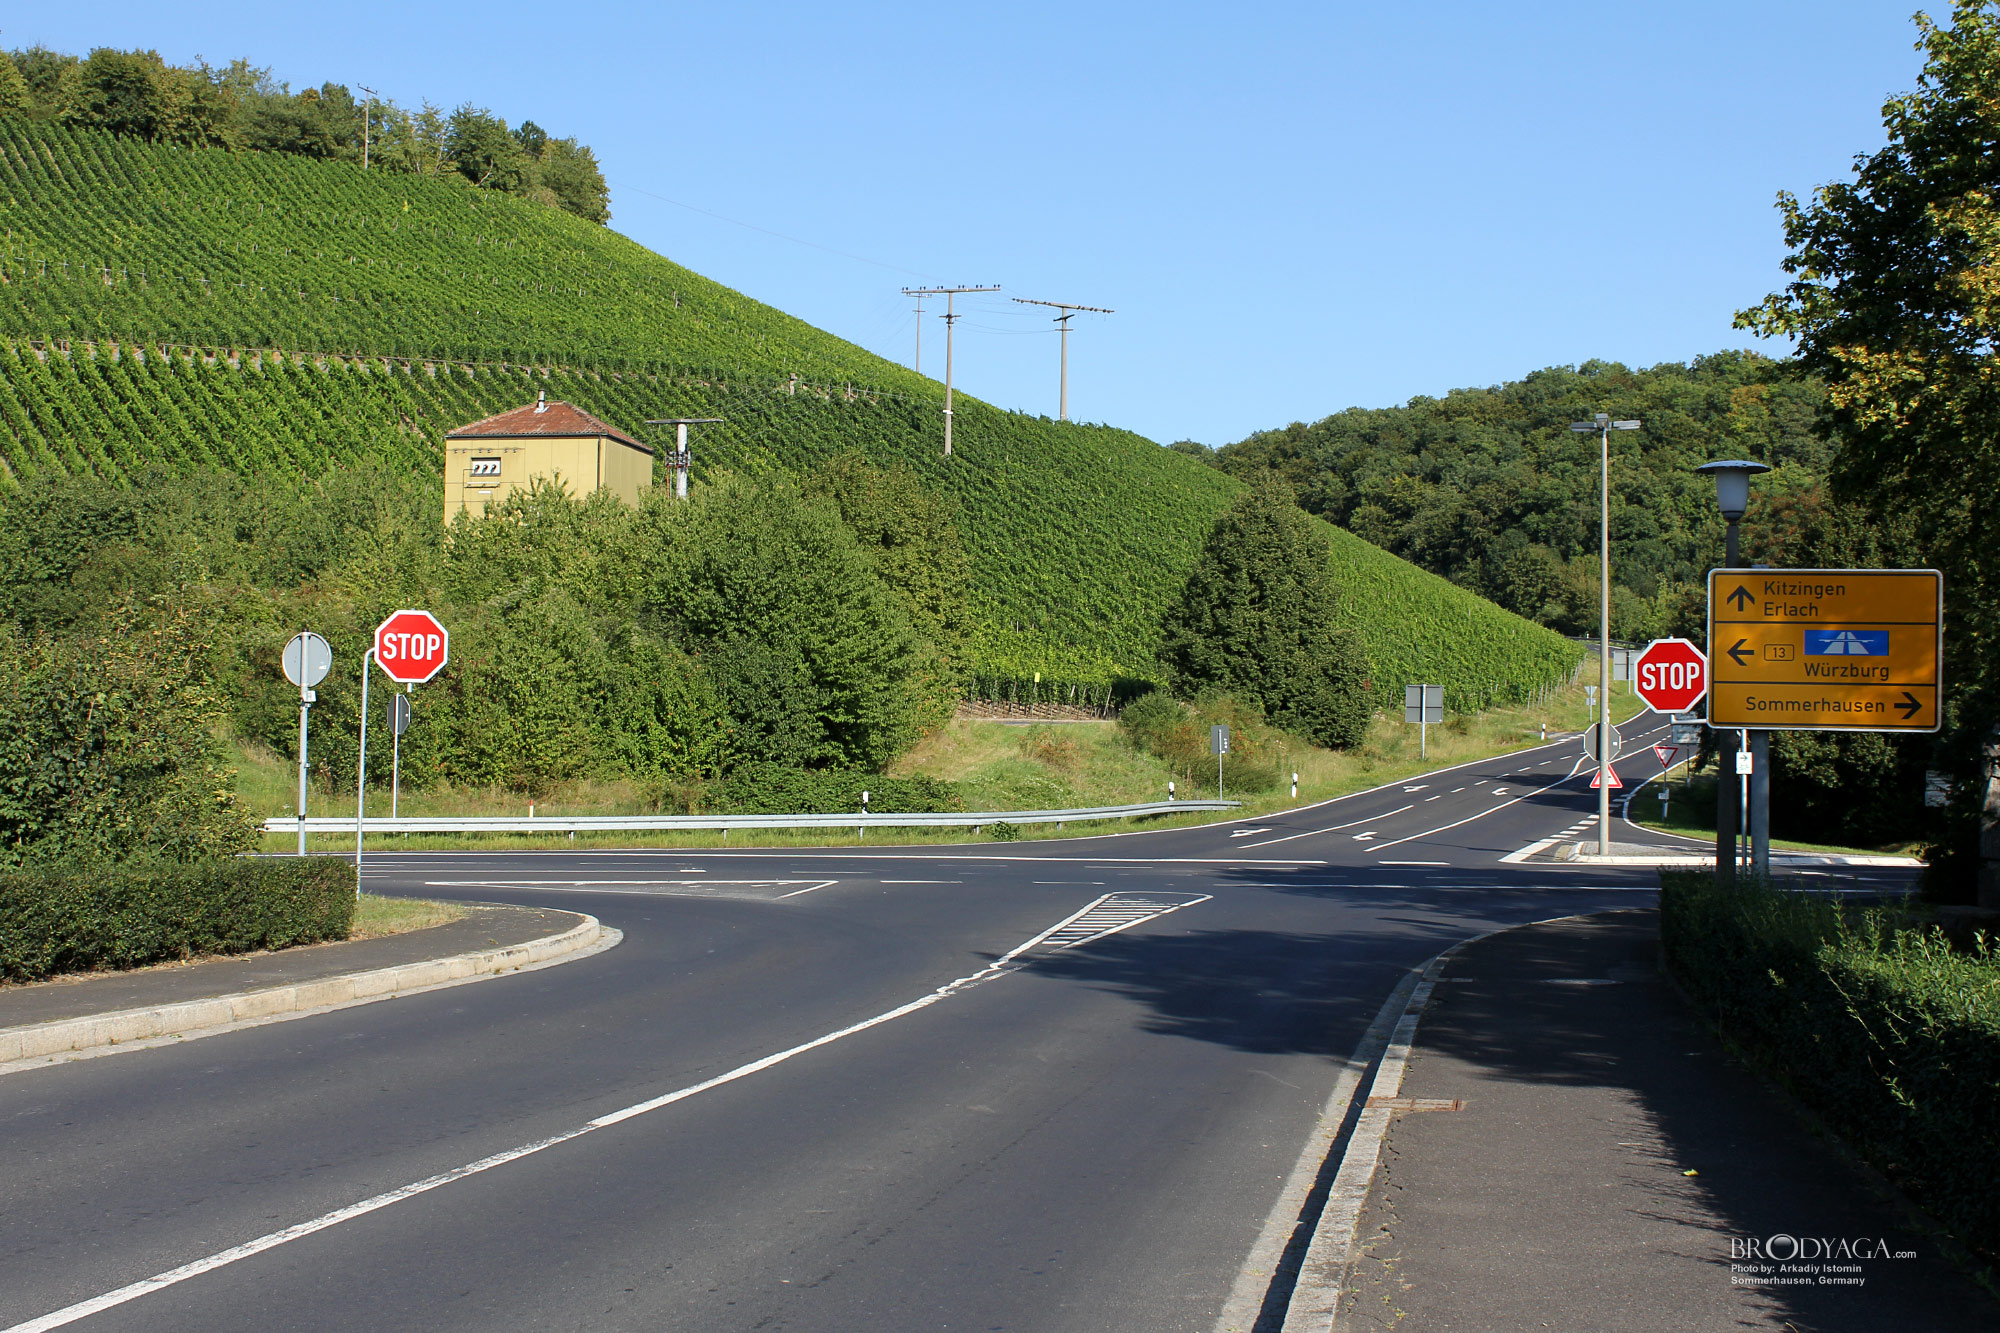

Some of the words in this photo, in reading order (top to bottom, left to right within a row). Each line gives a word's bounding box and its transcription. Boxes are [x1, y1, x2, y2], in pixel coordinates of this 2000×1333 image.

[1764, 581, 1845, 599] Kitzingen
[1764, 602, 1818, 616] Erlach
[383, 633, 440, 660] STOP
[1773, 647, 1785, 658] 13
[1642, 662, 1700, 690] STOP
[1804, 663, 1889, 681] Würzburg
[1746, 697, 1885, 712] Sommerhausen
